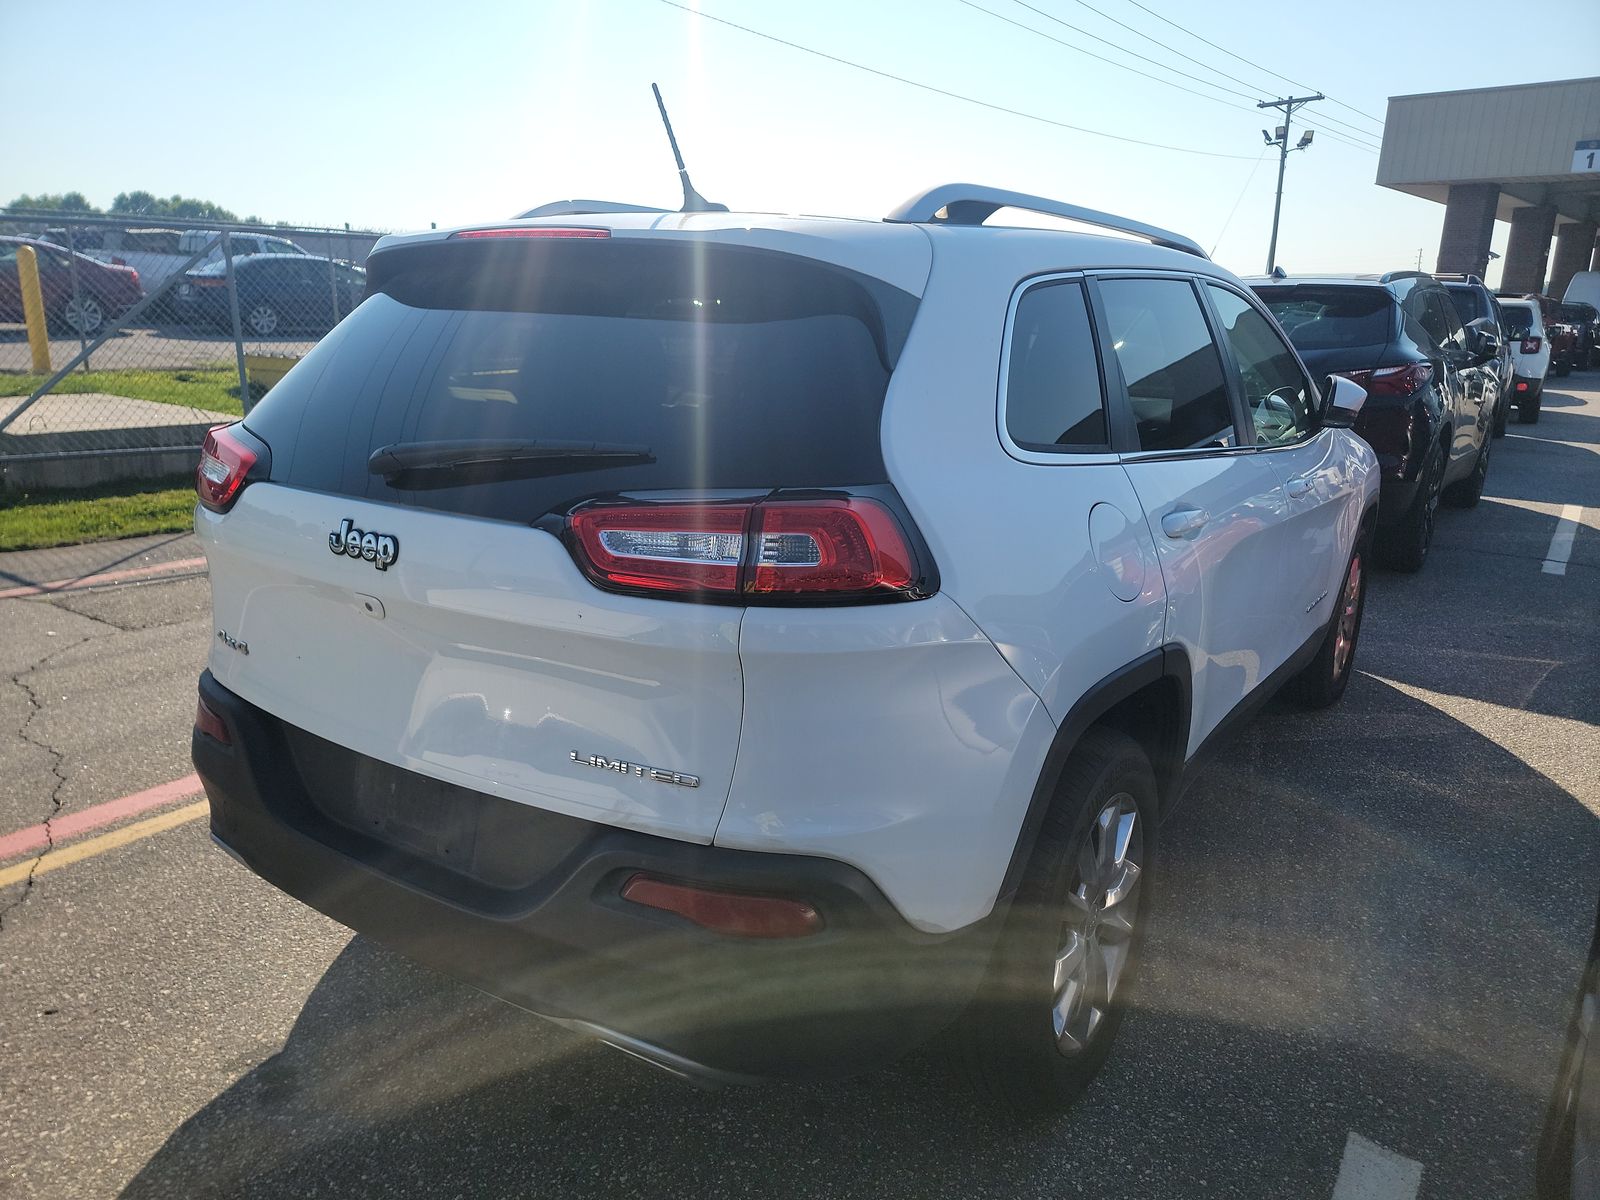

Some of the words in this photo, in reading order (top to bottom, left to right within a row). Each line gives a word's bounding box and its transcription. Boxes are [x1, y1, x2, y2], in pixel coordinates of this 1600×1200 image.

[1586, 152, 1595, 169] 1
[329, 518, 399, 571] Jeep
[569, 749, 700, 788] LIMITED
